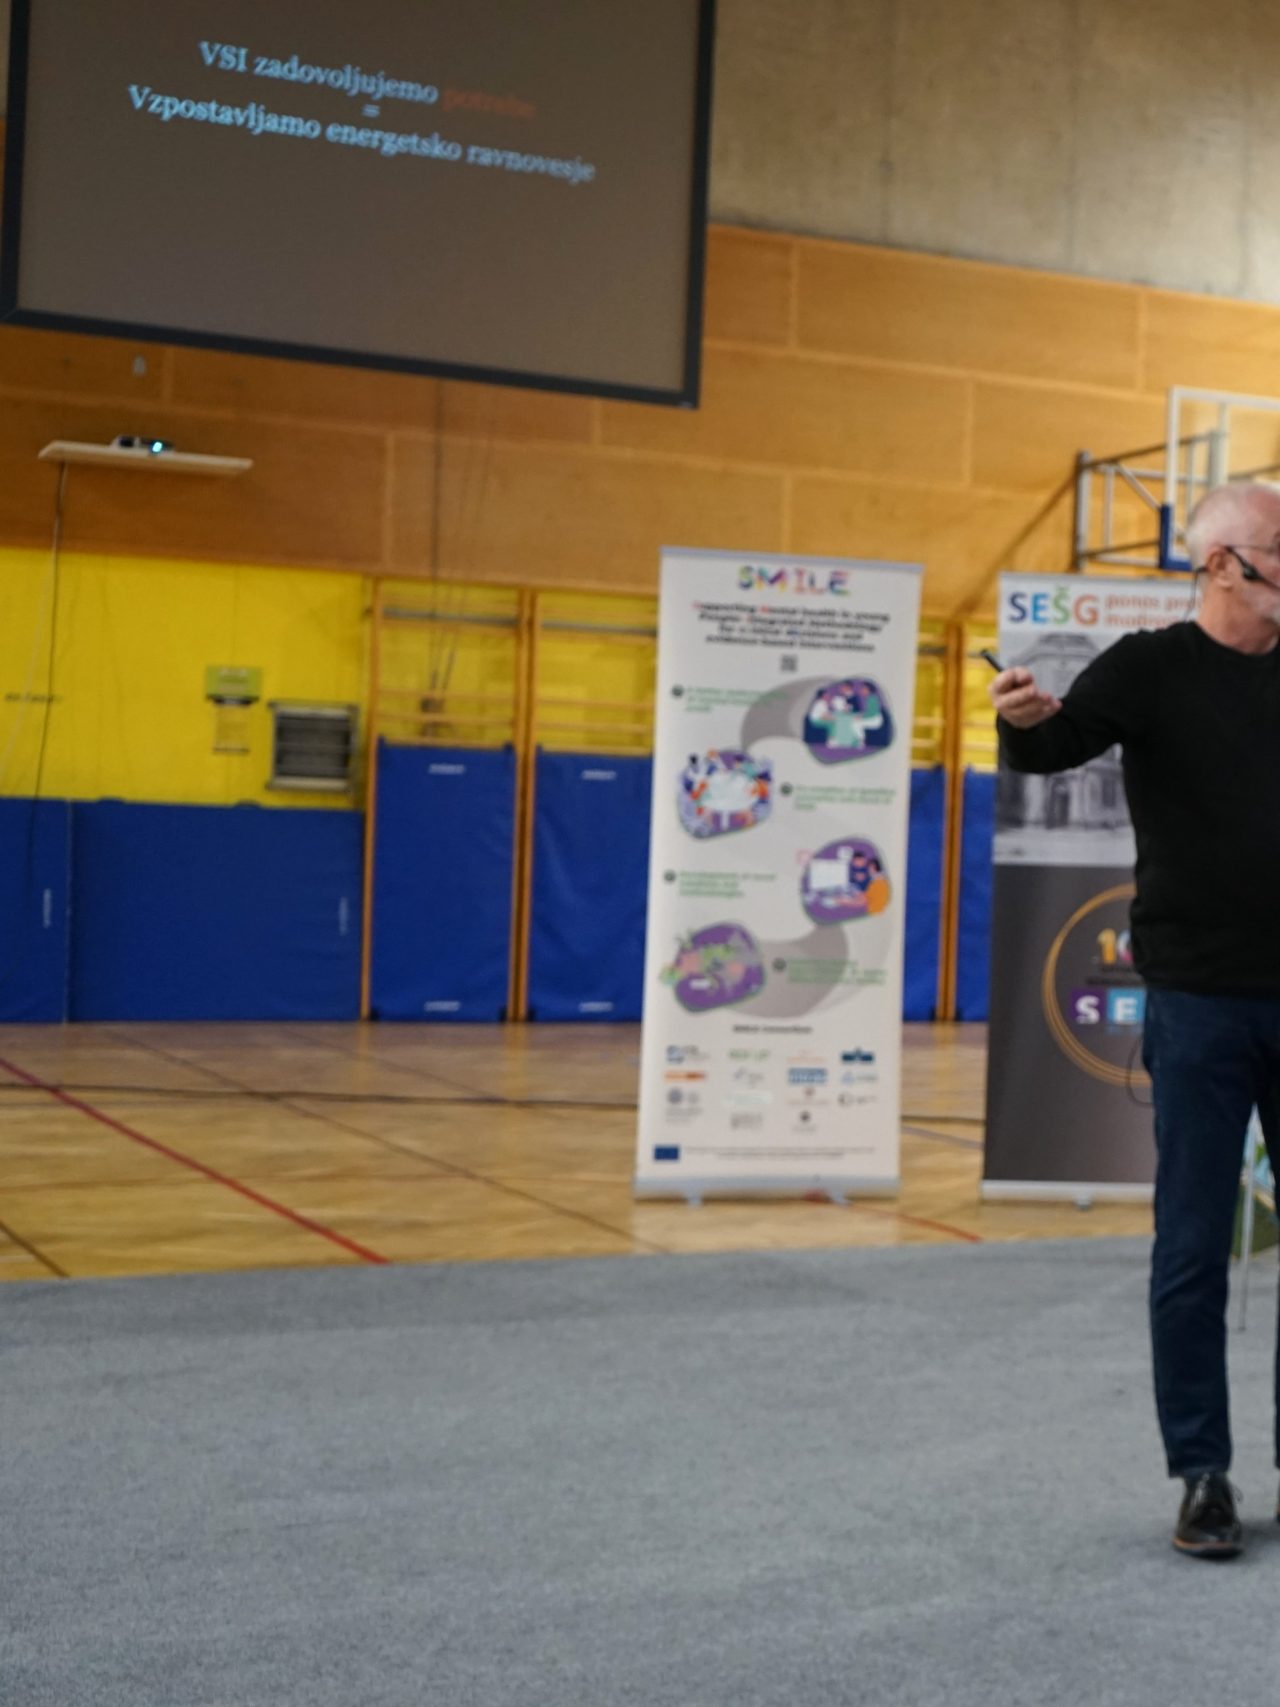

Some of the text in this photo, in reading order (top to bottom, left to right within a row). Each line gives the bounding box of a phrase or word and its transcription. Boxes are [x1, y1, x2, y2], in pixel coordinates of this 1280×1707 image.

[199, 41, 249, 73] VSI
[254, 55, 438, 104] zadovoljujemo
[128, 85, 595, 185] Vzpostavljamo energetsko ravnovesje
[738, 565, 850, 596] SMILE
[1009, 585, 1099, 626] SEŠG
